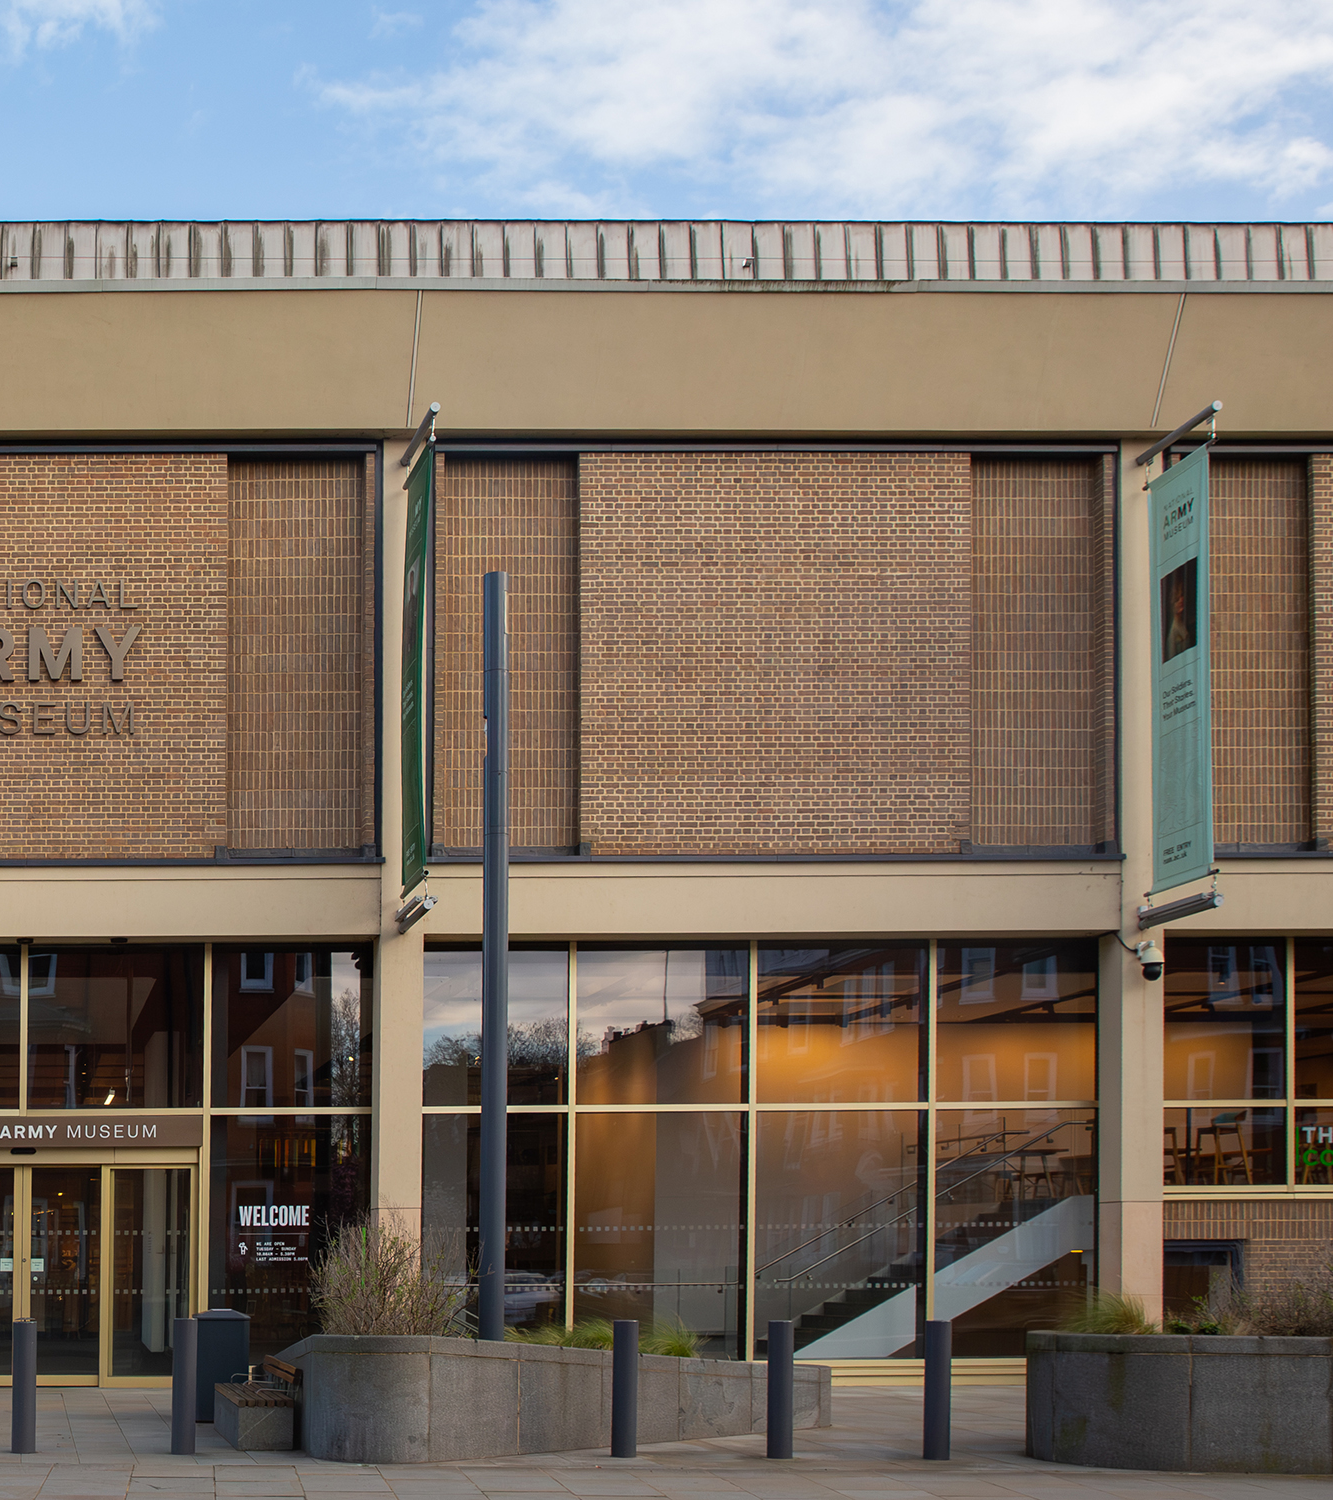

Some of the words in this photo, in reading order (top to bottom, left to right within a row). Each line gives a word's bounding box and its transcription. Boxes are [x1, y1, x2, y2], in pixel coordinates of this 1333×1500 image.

[1163, 497, 1195, 530] ARMY
[1163, 515, 1194, 542] MUSEUM
[1163, 846, 1174, 856] FREE
[1176, 840, 1192, 852] ENTRY
[0, 1124, 58, 1139] ARMY
[67, 1124, 157, 1139] MUSEUM
[1301, 1126, 1333, 1144] TH
[1303, 1149, 1333, 1166] CO
[238, 1205, 310, 1227] WELCOME
